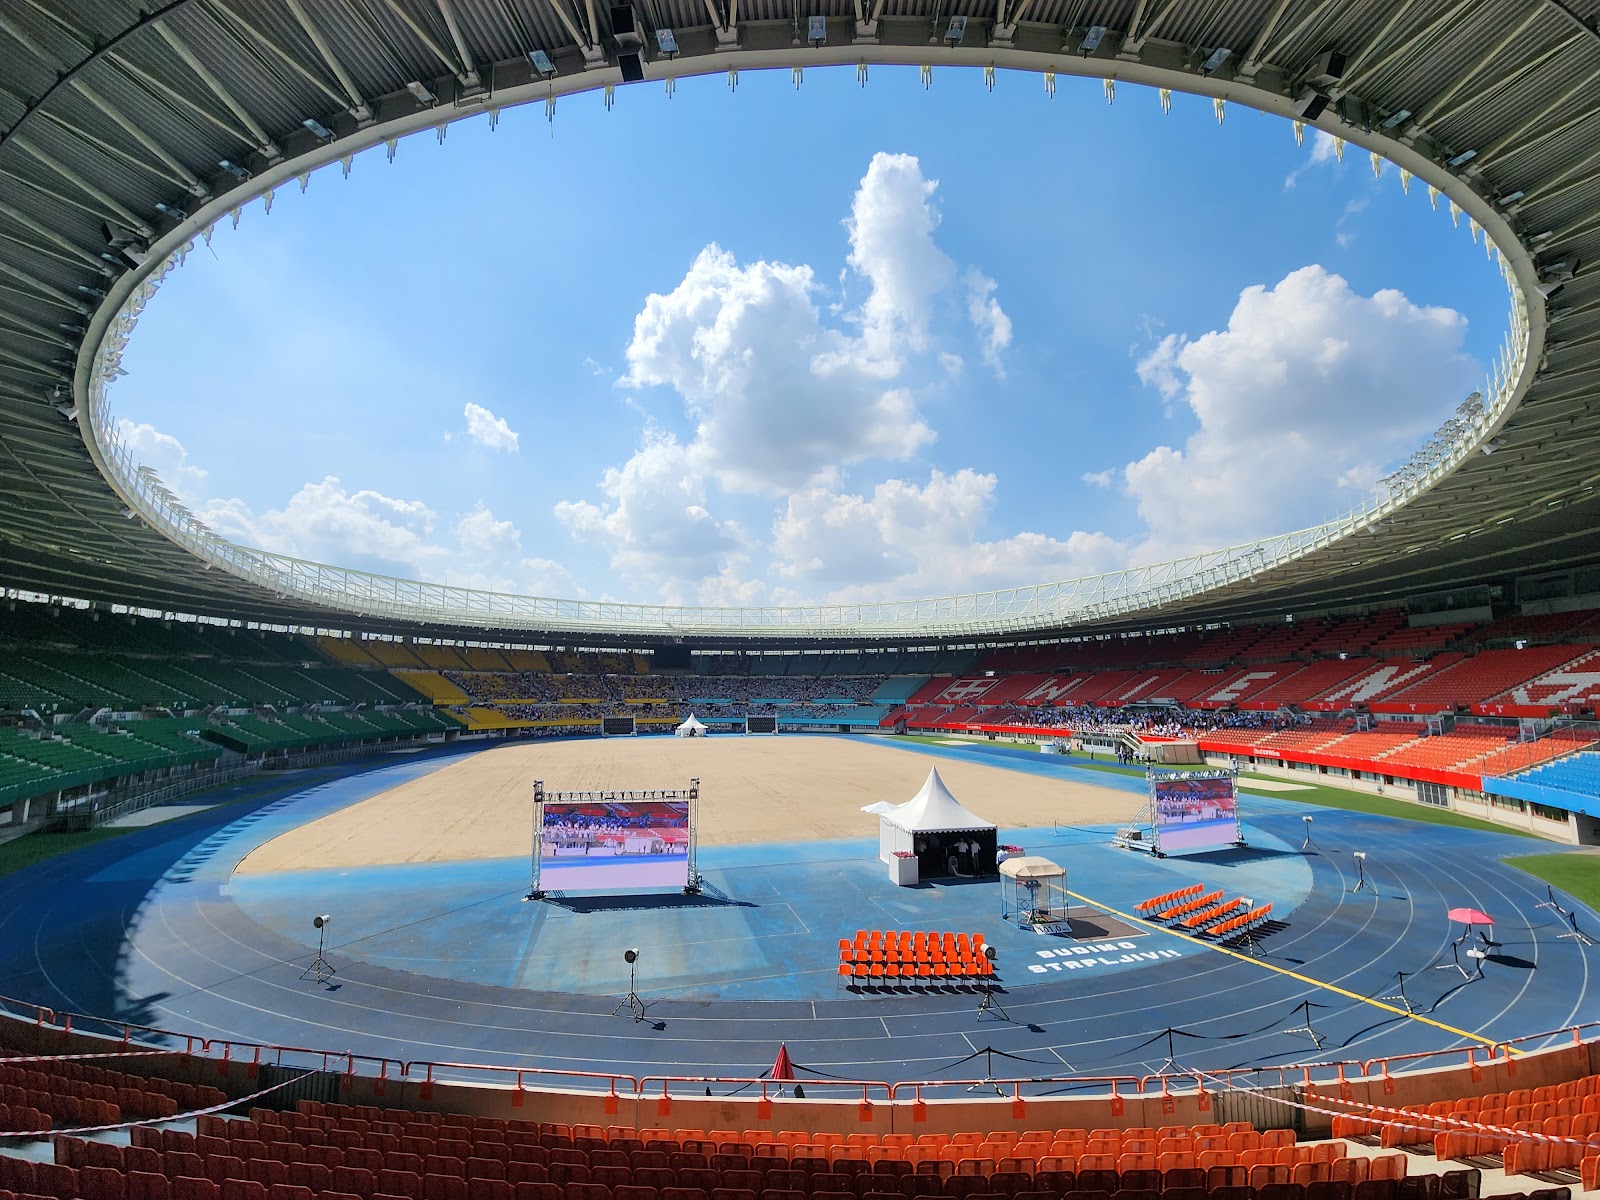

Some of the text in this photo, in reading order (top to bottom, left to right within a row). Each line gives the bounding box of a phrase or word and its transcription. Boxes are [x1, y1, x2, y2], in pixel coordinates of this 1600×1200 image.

[1025, 664, 1433, 702] WIEN
[1027, 949, 1183, 974] STRPLJIVI!
[1036, 941, 1137, 959] BUDIMO
